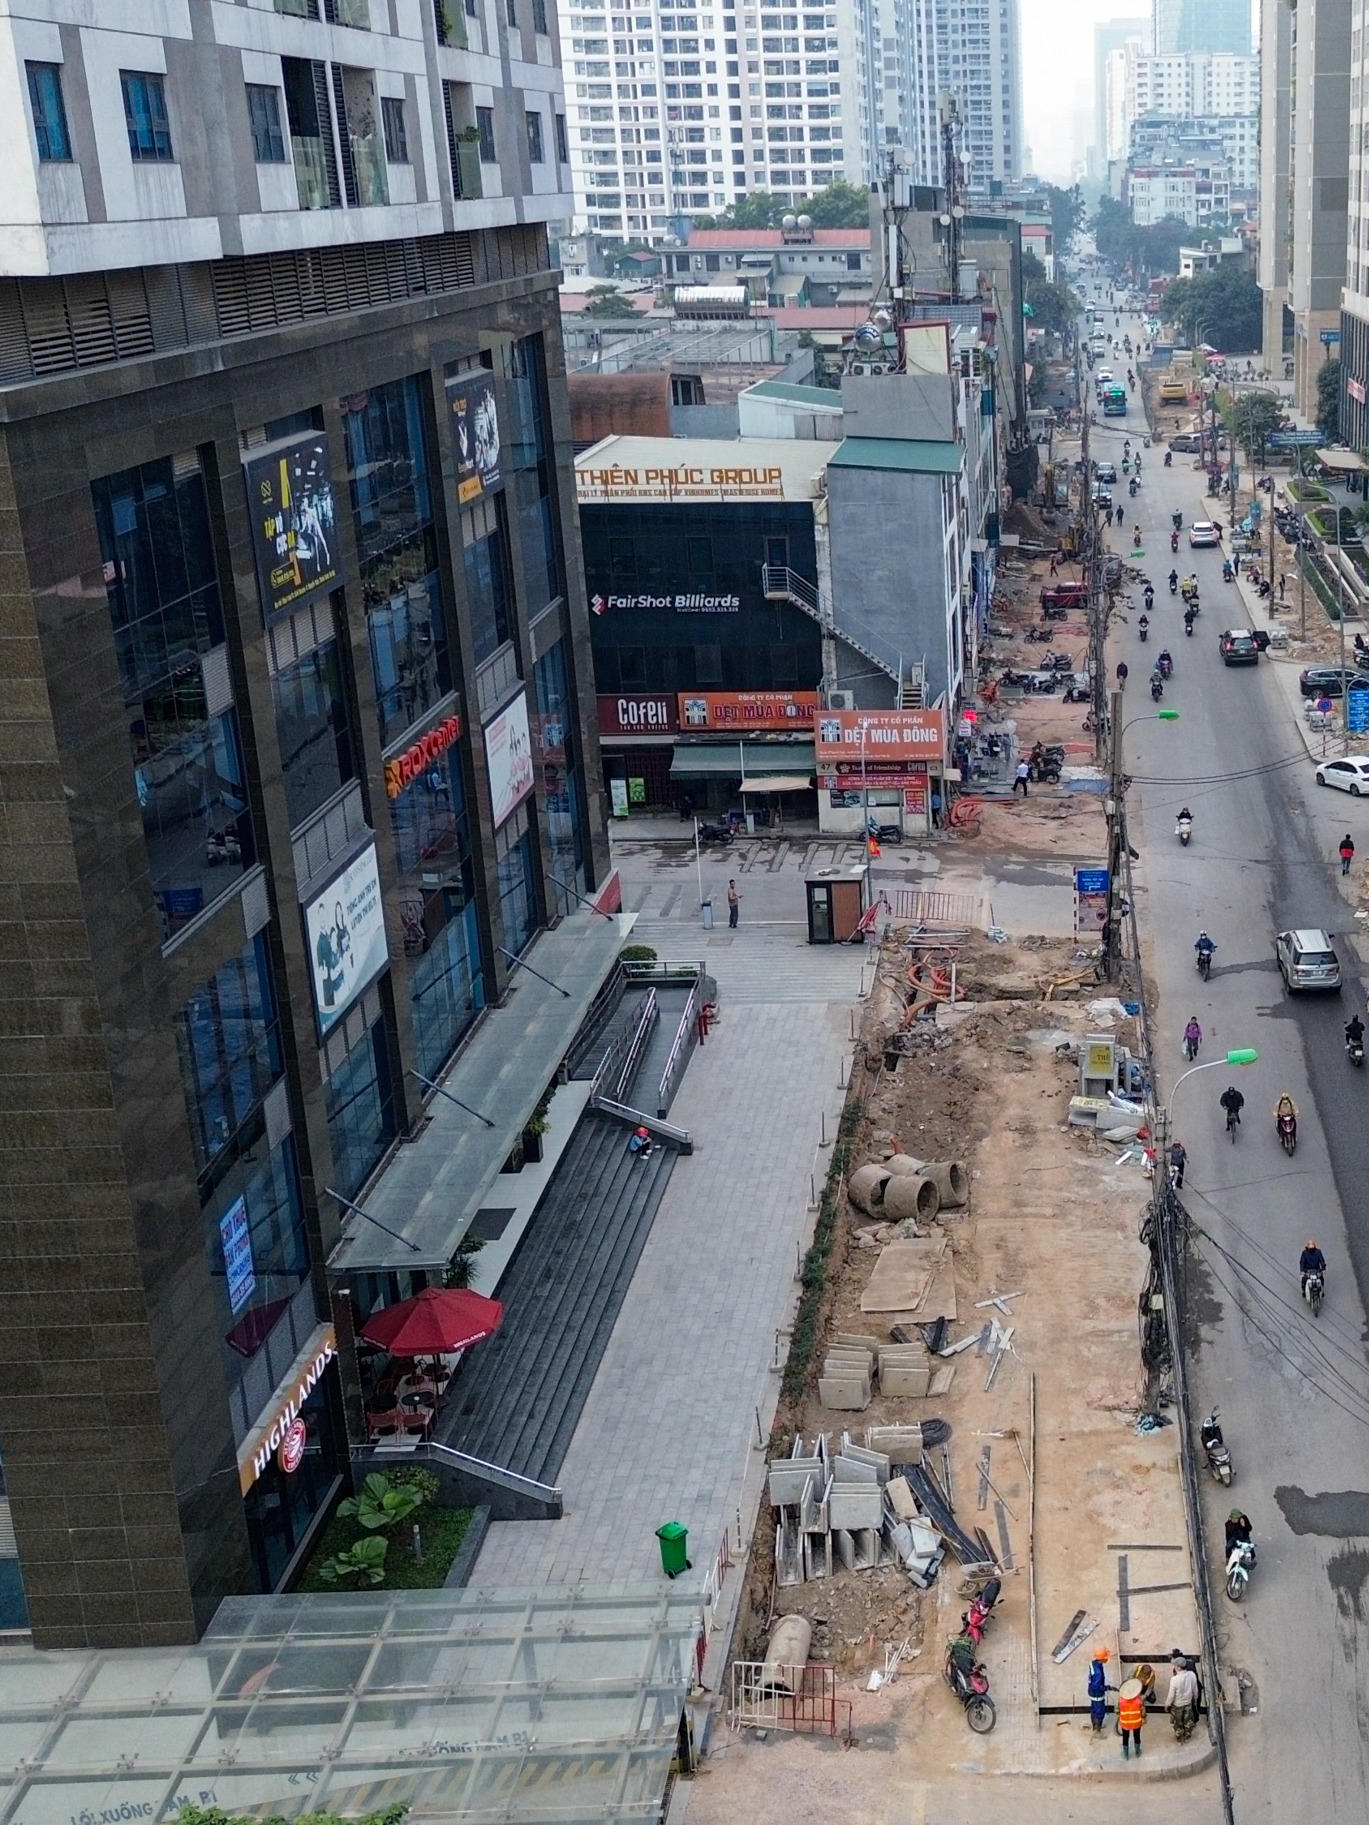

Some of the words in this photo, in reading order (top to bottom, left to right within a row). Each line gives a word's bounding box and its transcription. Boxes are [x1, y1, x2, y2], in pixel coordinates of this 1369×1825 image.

[576, 463, 638, 485] THIÊN
[645, 463, 704, 485] PHÚC
[710, 467, 783, 485] GROUP
[607, 594, 672, 608] FairShot
[674, 593, 740, 608] Billiards
[844, 726, 868, 746] DỆT
[871, 725, 901, 744] MÙA
[902, 725, 938, 743] ĐÔNG
[253, 1340, 333, 1480] HIGHLANDS
